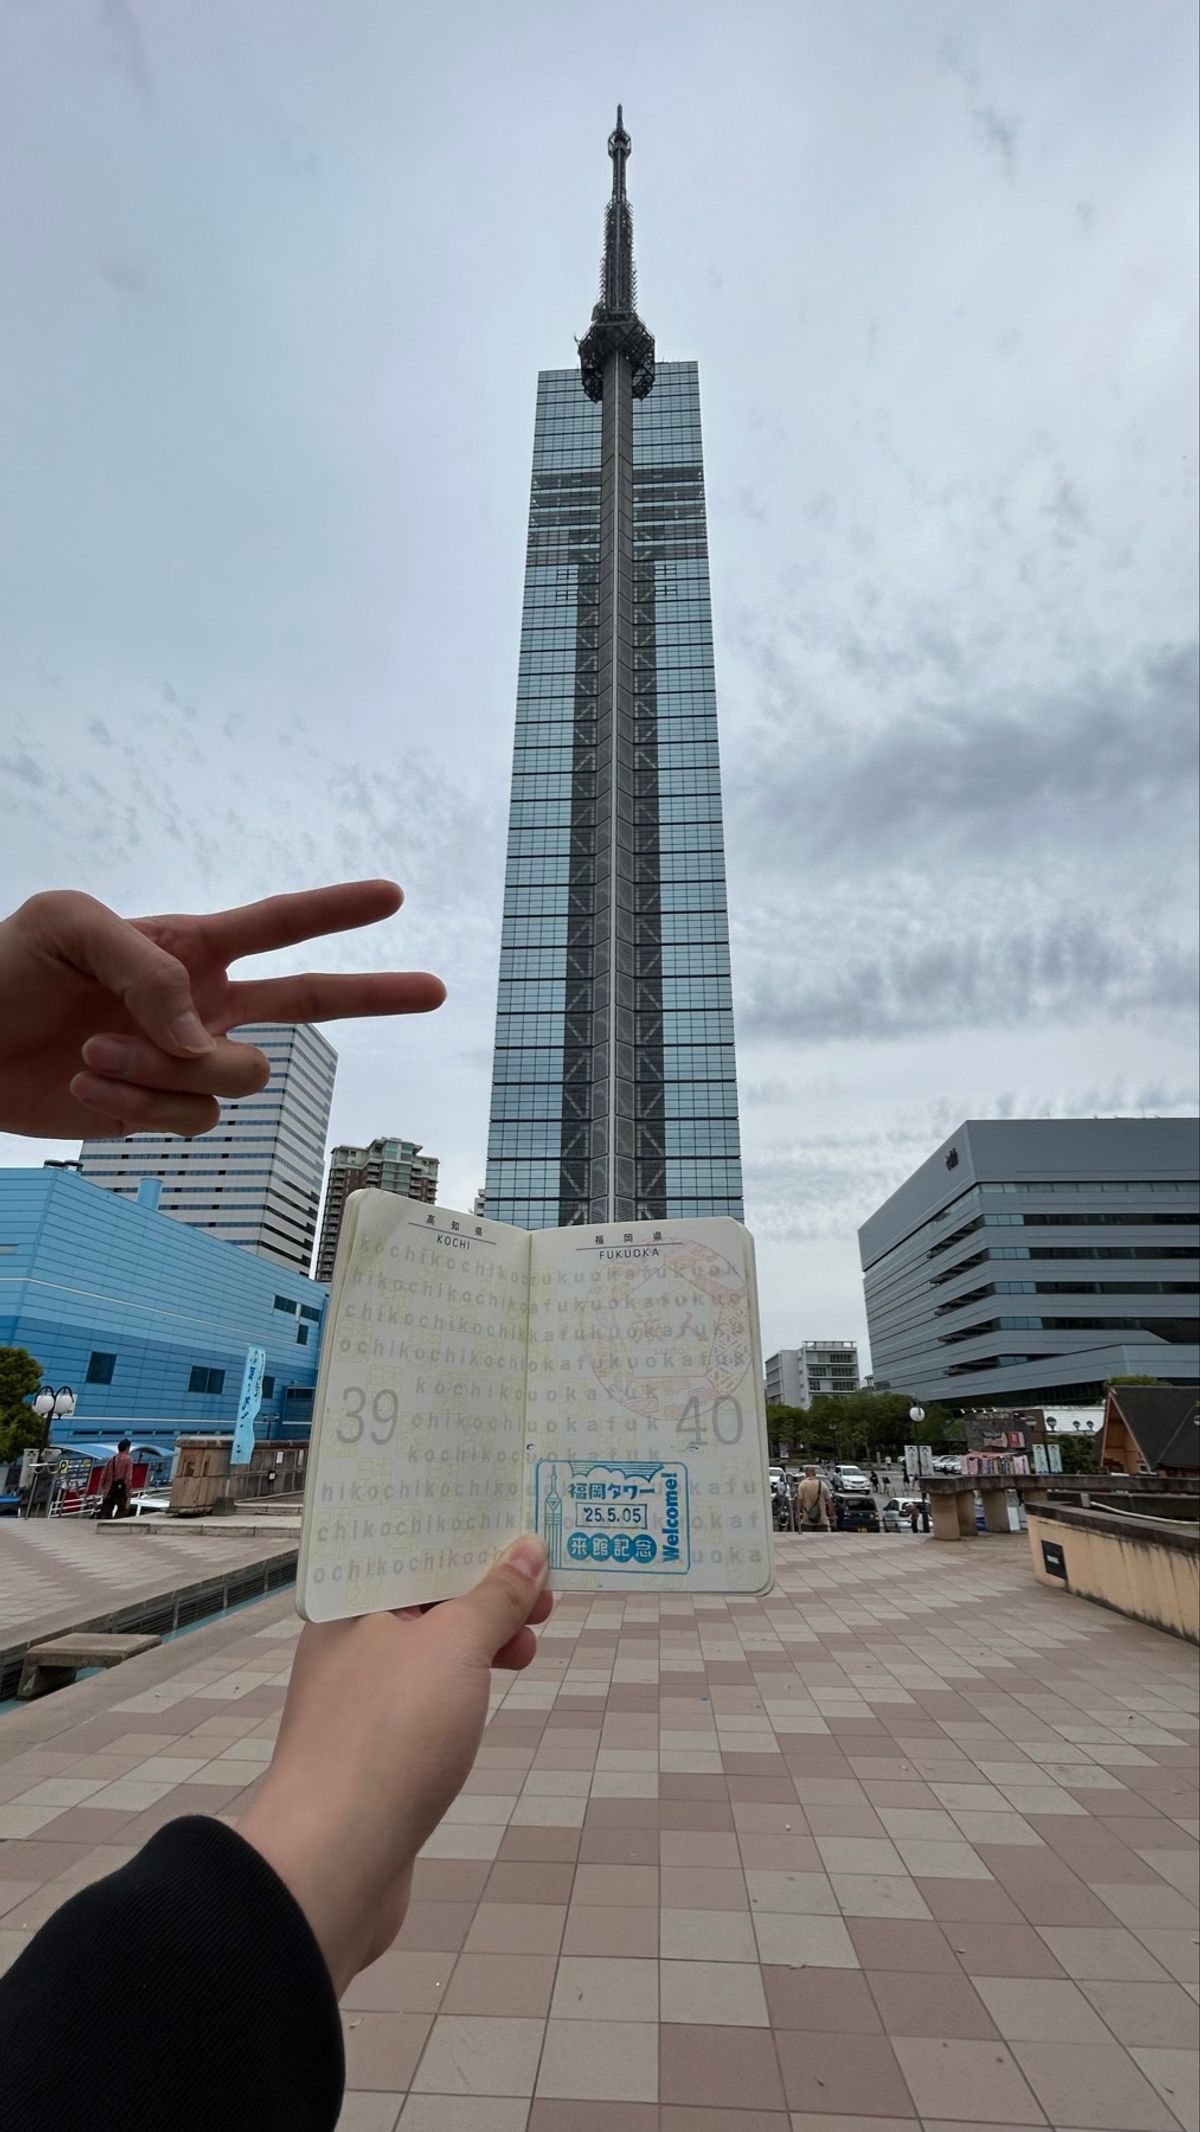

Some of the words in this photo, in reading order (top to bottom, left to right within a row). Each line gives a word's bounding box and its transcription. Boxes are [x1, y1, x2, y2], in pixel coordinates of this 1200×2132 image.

[426, 1214, 483, 1237] 高知県
[437, 1234, 471, 1251] KOCHI
[595, 1231, 662, 1245] 福岡県
[599, 1247, 660, 1260] FUKUOKA
[337, 1386, 398, 1445] 39
[676, 1395, 744, 1446] 40
[568, 1483, 655, 1500] 福岡タワー
[661, 1472, 680, 1563] Welcome!
[570, 1535, 653, 1559] 来館記念
